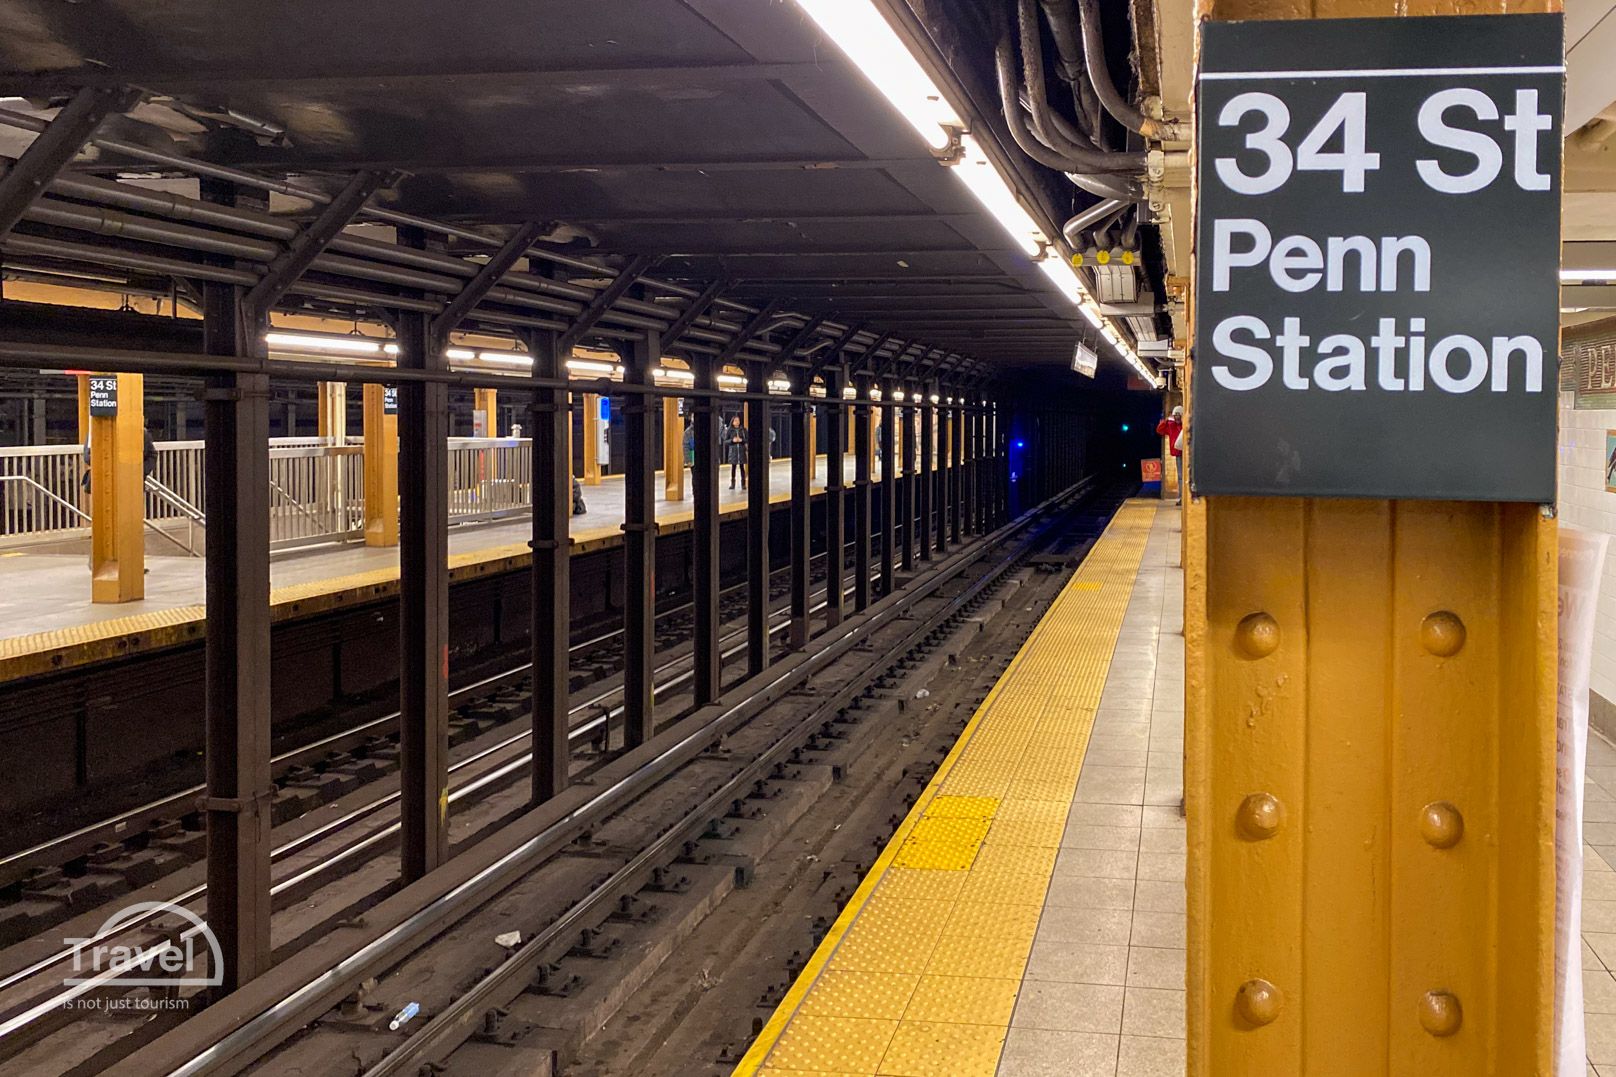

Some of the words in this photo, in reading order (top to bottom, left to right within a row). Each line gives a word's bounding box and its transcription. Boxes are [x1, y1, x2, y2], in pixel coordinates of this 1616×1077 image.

[1214, 92, 1381, 195] 34
[1415, 88, 1552, 194] St
[1212, 218, 1431, 293] Penn
[1211, 315, 1543, 393] Station
[1587, 345, 1616, 389] PE
[90, 381, 104, 390] 34
[105, 381, 117, 390] St
[90, 391, 109, 399] Penn
[90, 399, 117, 407] Station
